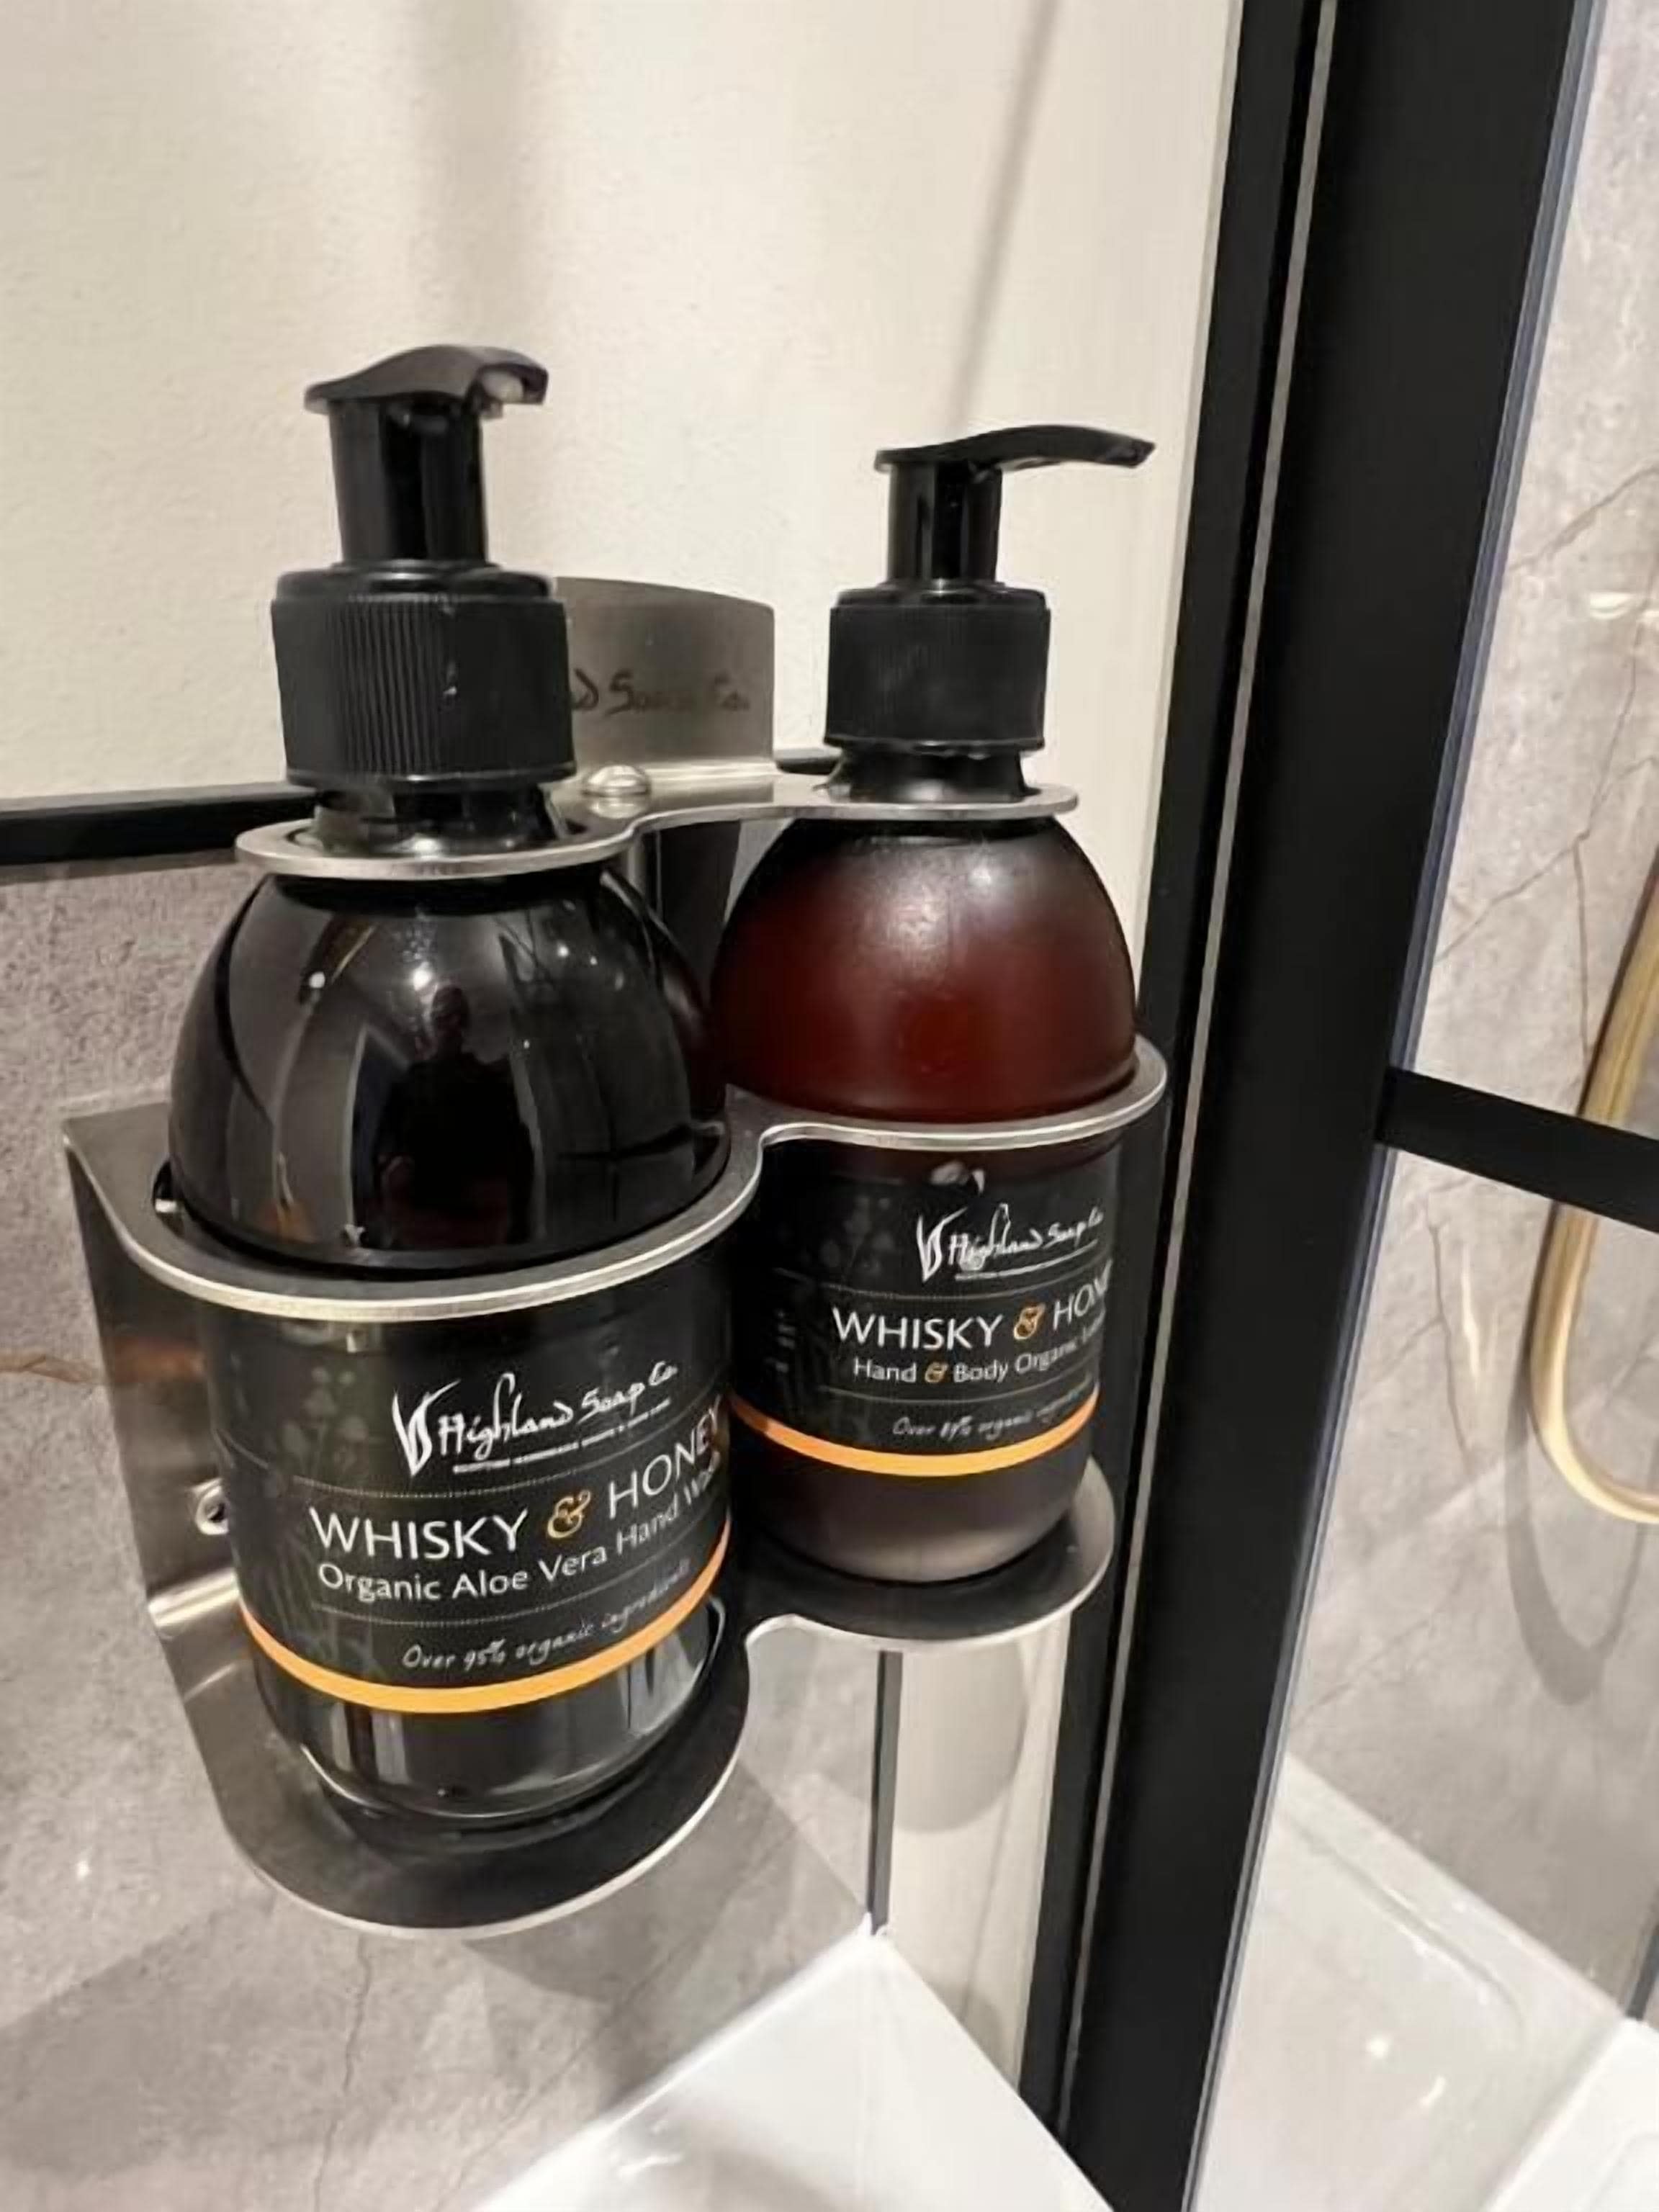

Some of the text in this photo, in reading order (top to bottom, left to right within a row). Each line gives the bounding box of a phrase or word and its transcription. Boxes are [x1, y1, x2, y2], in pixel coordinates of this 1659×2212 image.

[832, 1305, 1003, 1350] WHISKY
[1013, 1303, 1046, 1341] &
[853, 1357, 917, 1383] Hand
[925, 1359, 948, 1384] &
[953, 1359, 1009, 1385] Body
[437, 1372, 575, 1460] Highland
[578, 1382, 647, 1425] Soap
[309, 1505, 528, 1560] WHISKY
[547, 1489, 592, 1540] &
[318, 1563, 441, 1603] Organic
[451, 1568, 529, 1600] Aloe
[538, 1546, 607, 1582] Vera
[616, 1491, 680, 1555] Hand
[402, 1645, 456, 1671] Over
[515, 1614, 593, 1668] organic
